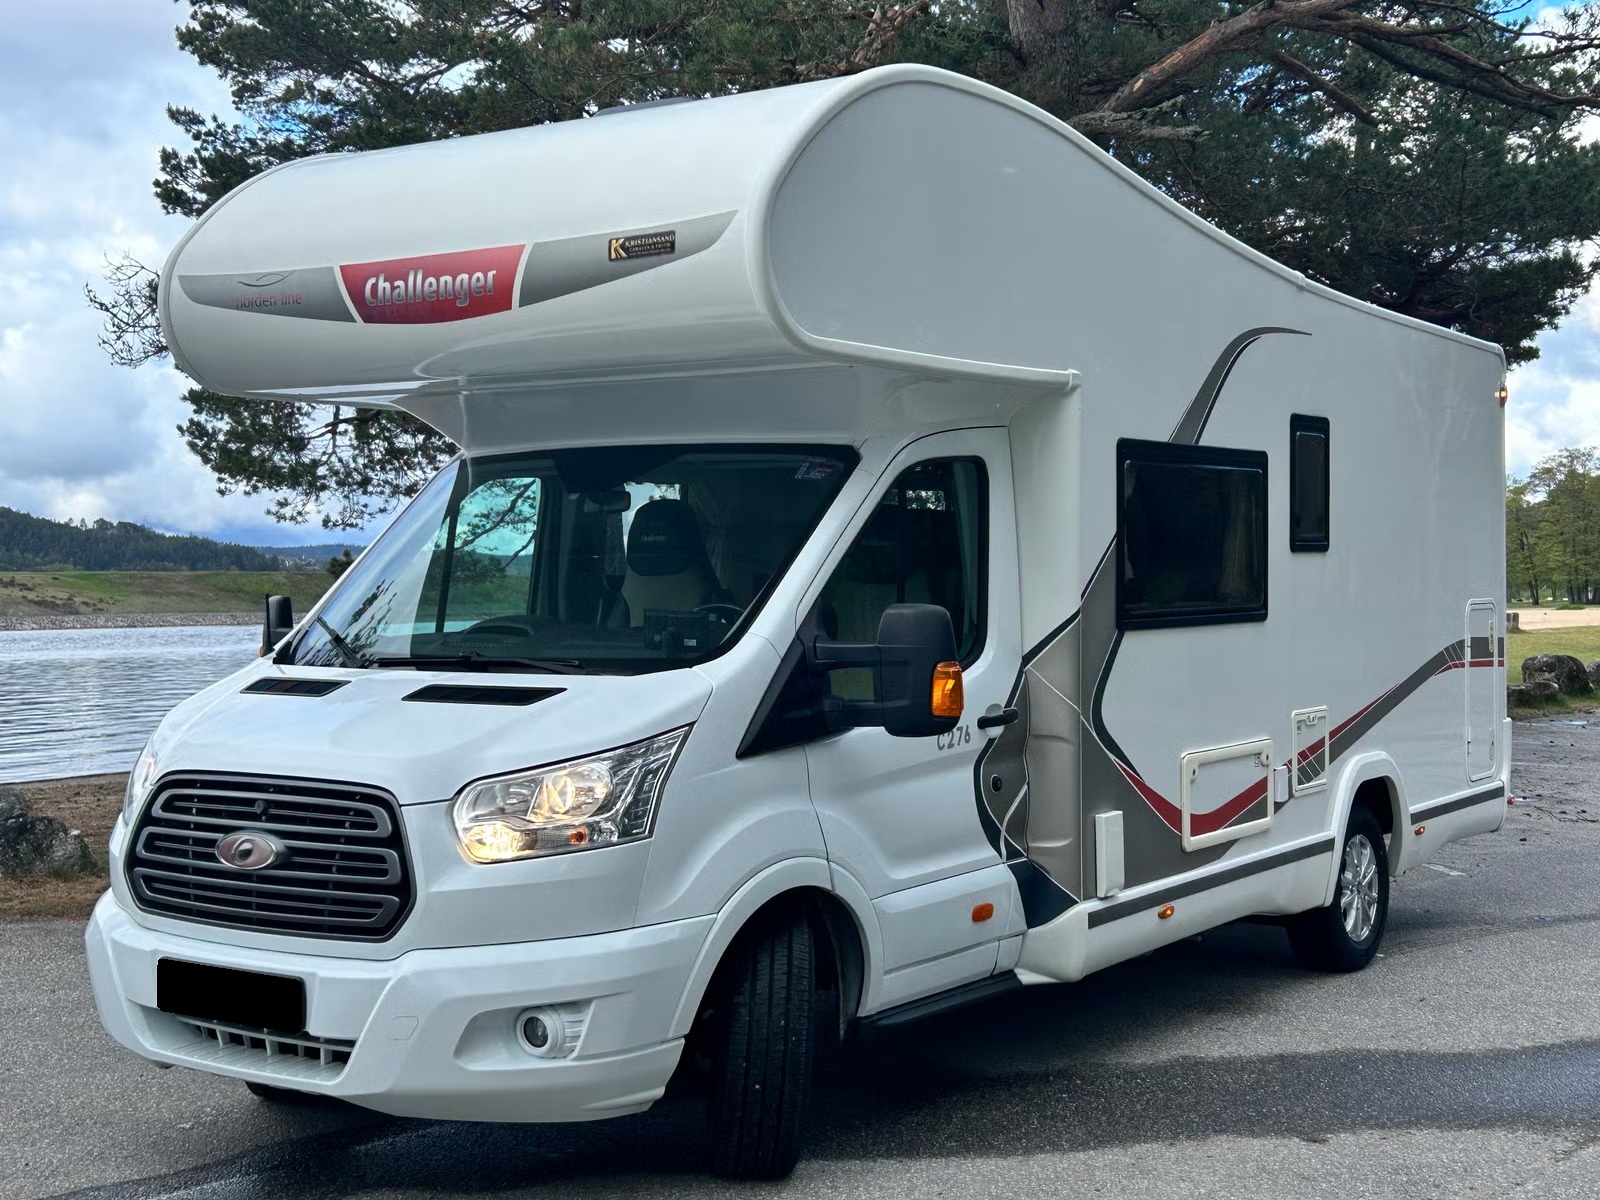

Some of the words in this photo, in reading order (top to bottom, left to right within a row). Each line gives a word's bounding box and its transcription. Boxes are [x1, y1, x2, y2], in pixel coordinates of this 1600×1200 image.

[625, 234, 675, 248] KRISTIANSAND
[364, 268, 497, 307] Challenger
[936, 725, 971, 751] C276
